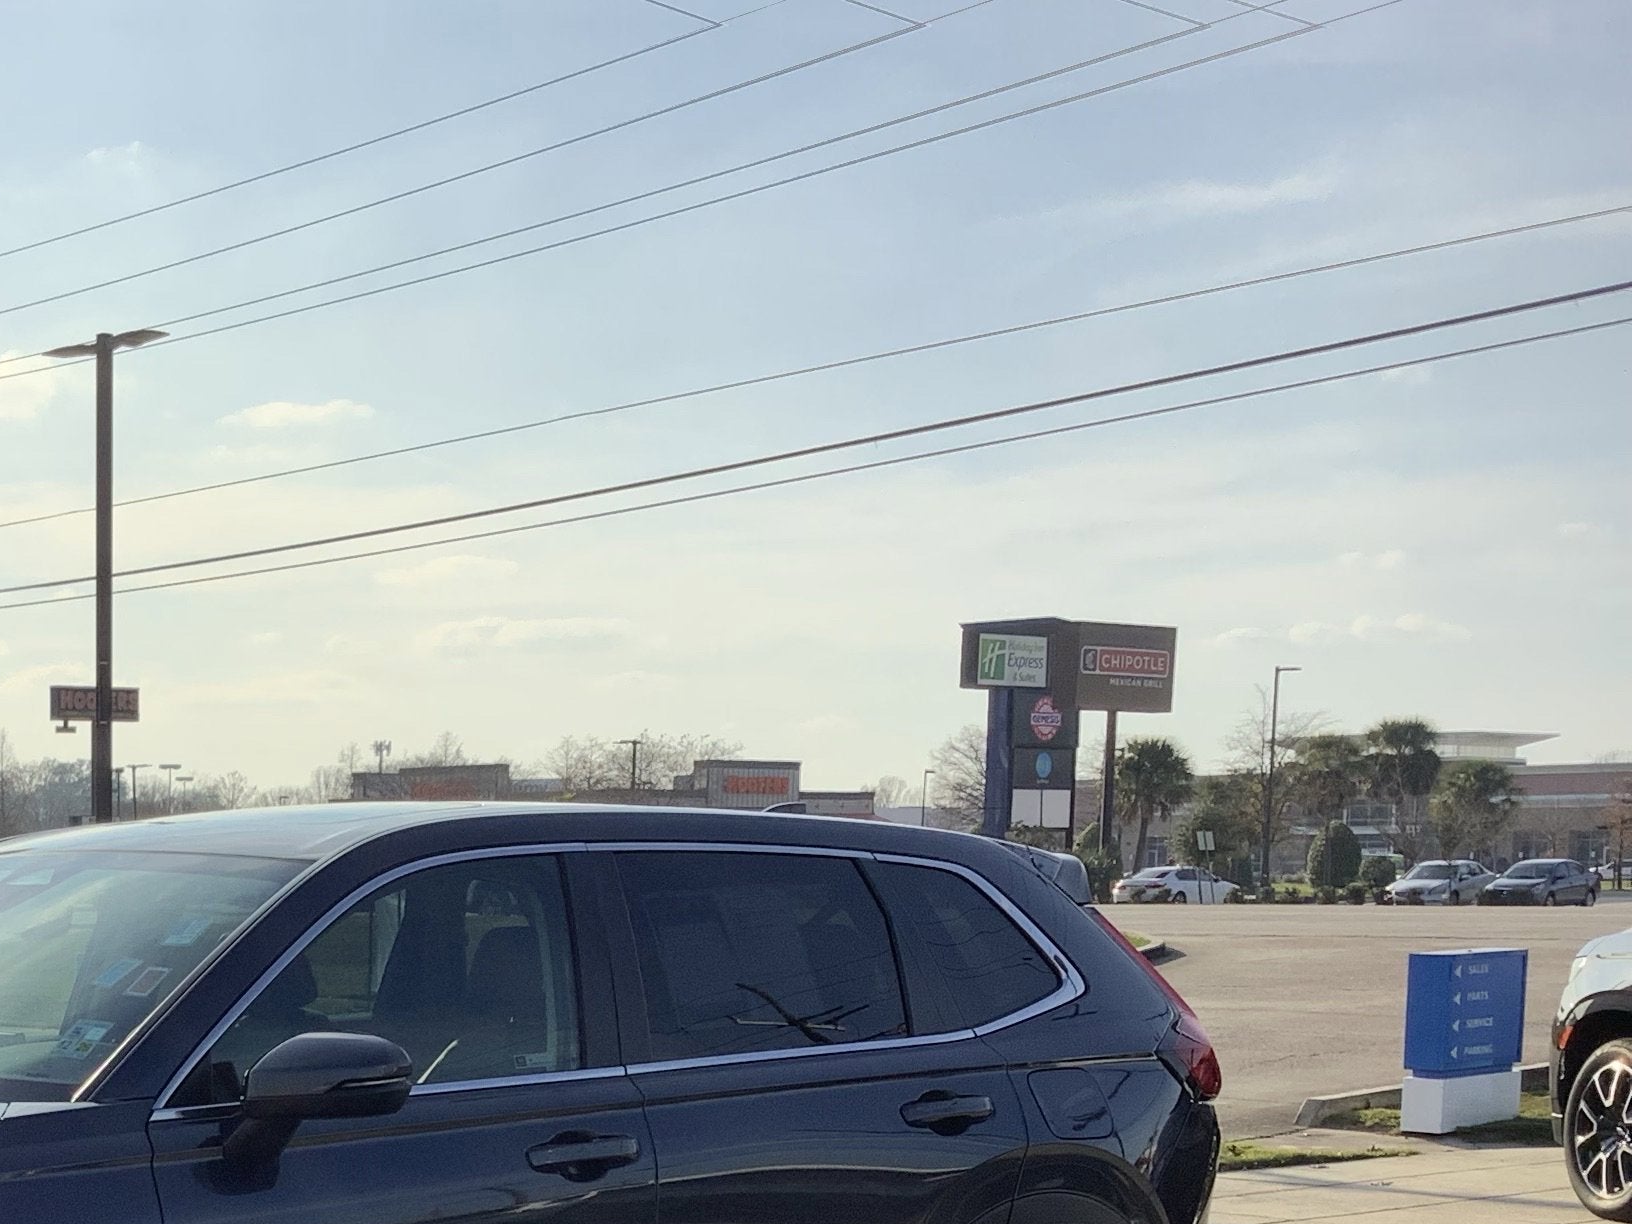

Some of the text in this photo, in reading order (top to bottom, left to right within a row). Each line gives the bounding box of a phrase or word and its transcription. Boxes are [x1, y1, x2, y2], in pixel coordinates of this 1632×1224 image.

[1007, 652, 1044, 671] Express
[1101, 654, 1165, 671] CHIPOTLE
[1109, 677, 1163, 689] MEXICAN GRILL
[1468, 963, 1489, 975] SALES
[1467, 990, 1489, 1001] PARTS
[1466, 1017, 1494, 1029] SERVICE
[1464, 1044, 1493, 1055] PARKING
